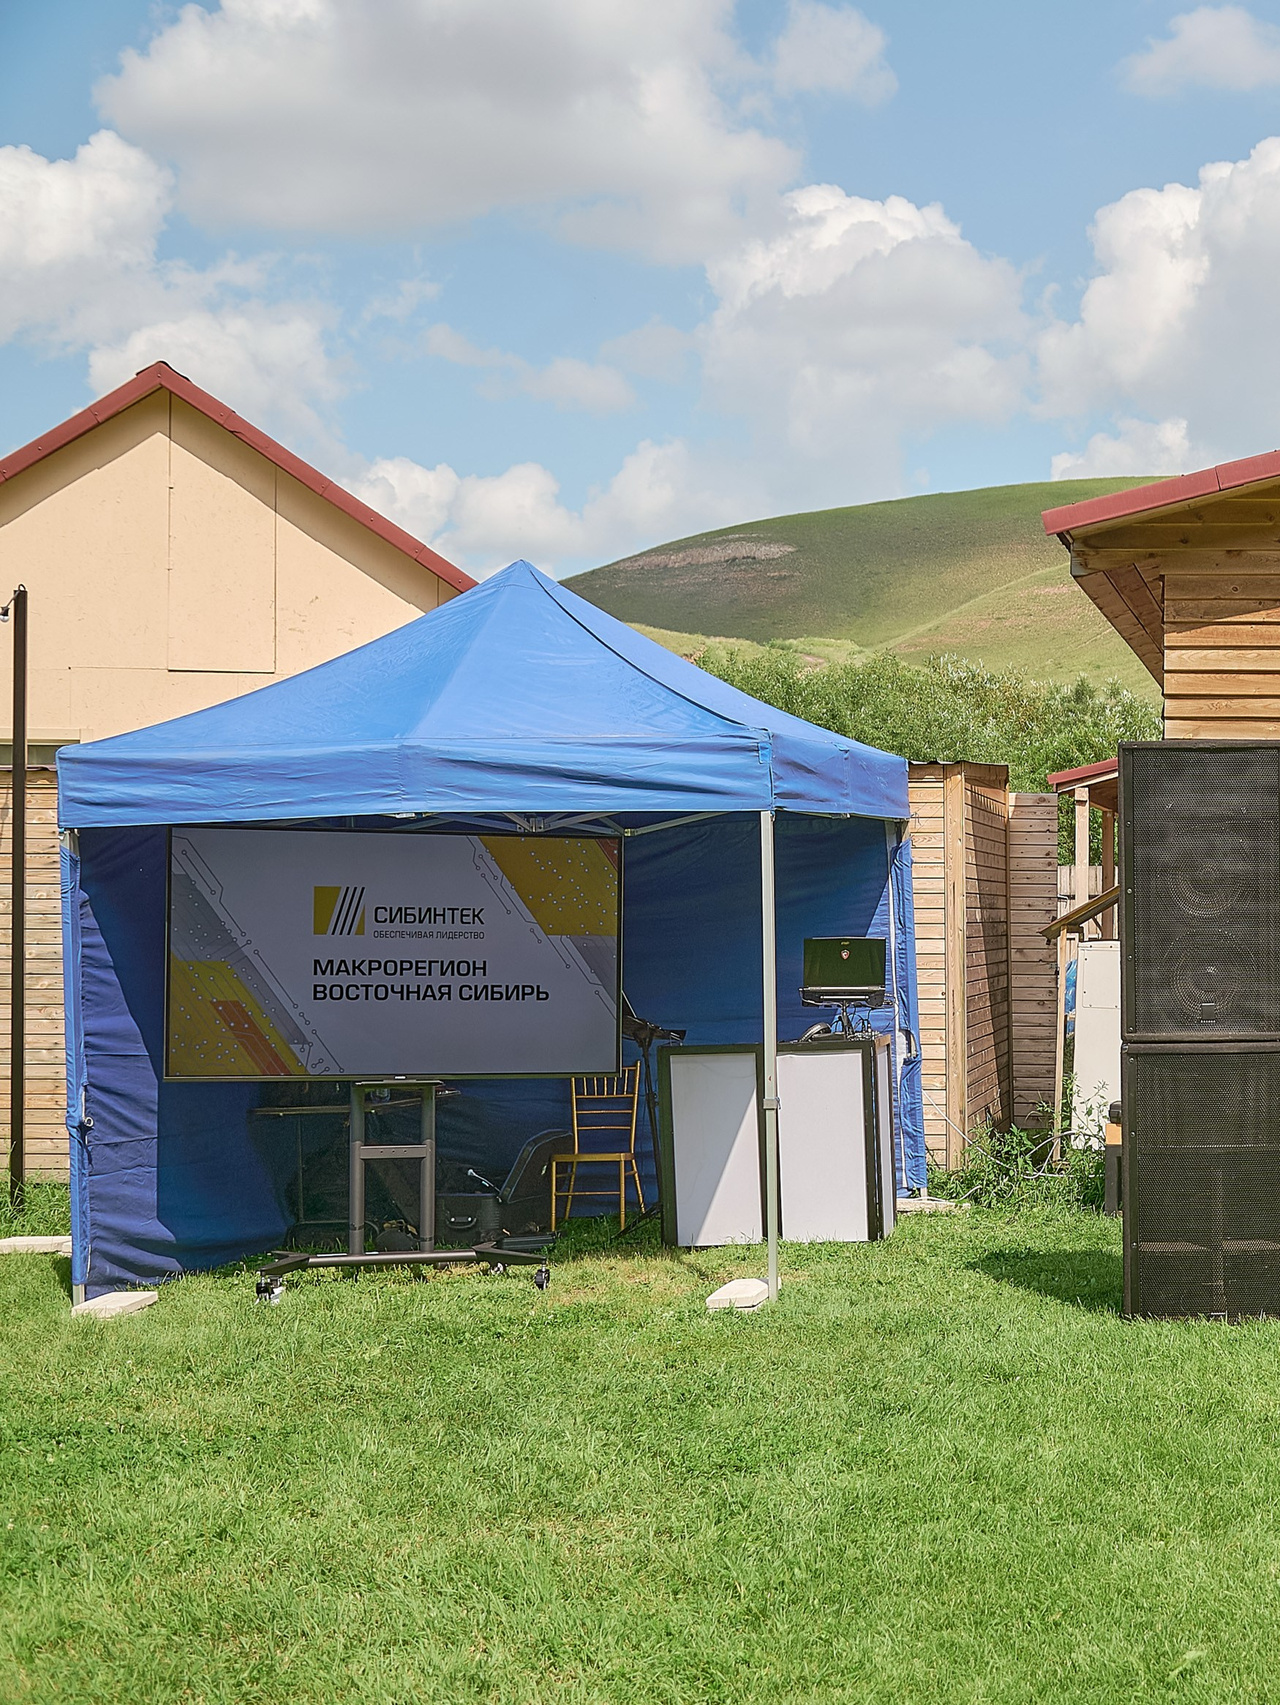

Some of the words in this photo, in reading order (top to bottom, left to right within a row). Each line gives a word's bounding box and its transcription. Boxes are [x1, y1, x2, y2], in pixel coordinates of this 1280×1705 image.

[374, 906, 485, 925] СИБИНТЕК
[373, 930, 434, 939] ОБЕСПЕЧИВАЯ
[435, 930, 485, 941] ЛИДЕРСТВО
[313, 959, 487, 977] МАКРОРЕГИОН
[313, 984, 452, 1001] ВОСТОЧНАЯ
[458, 984, 550, 1002] СИБИРЬ
